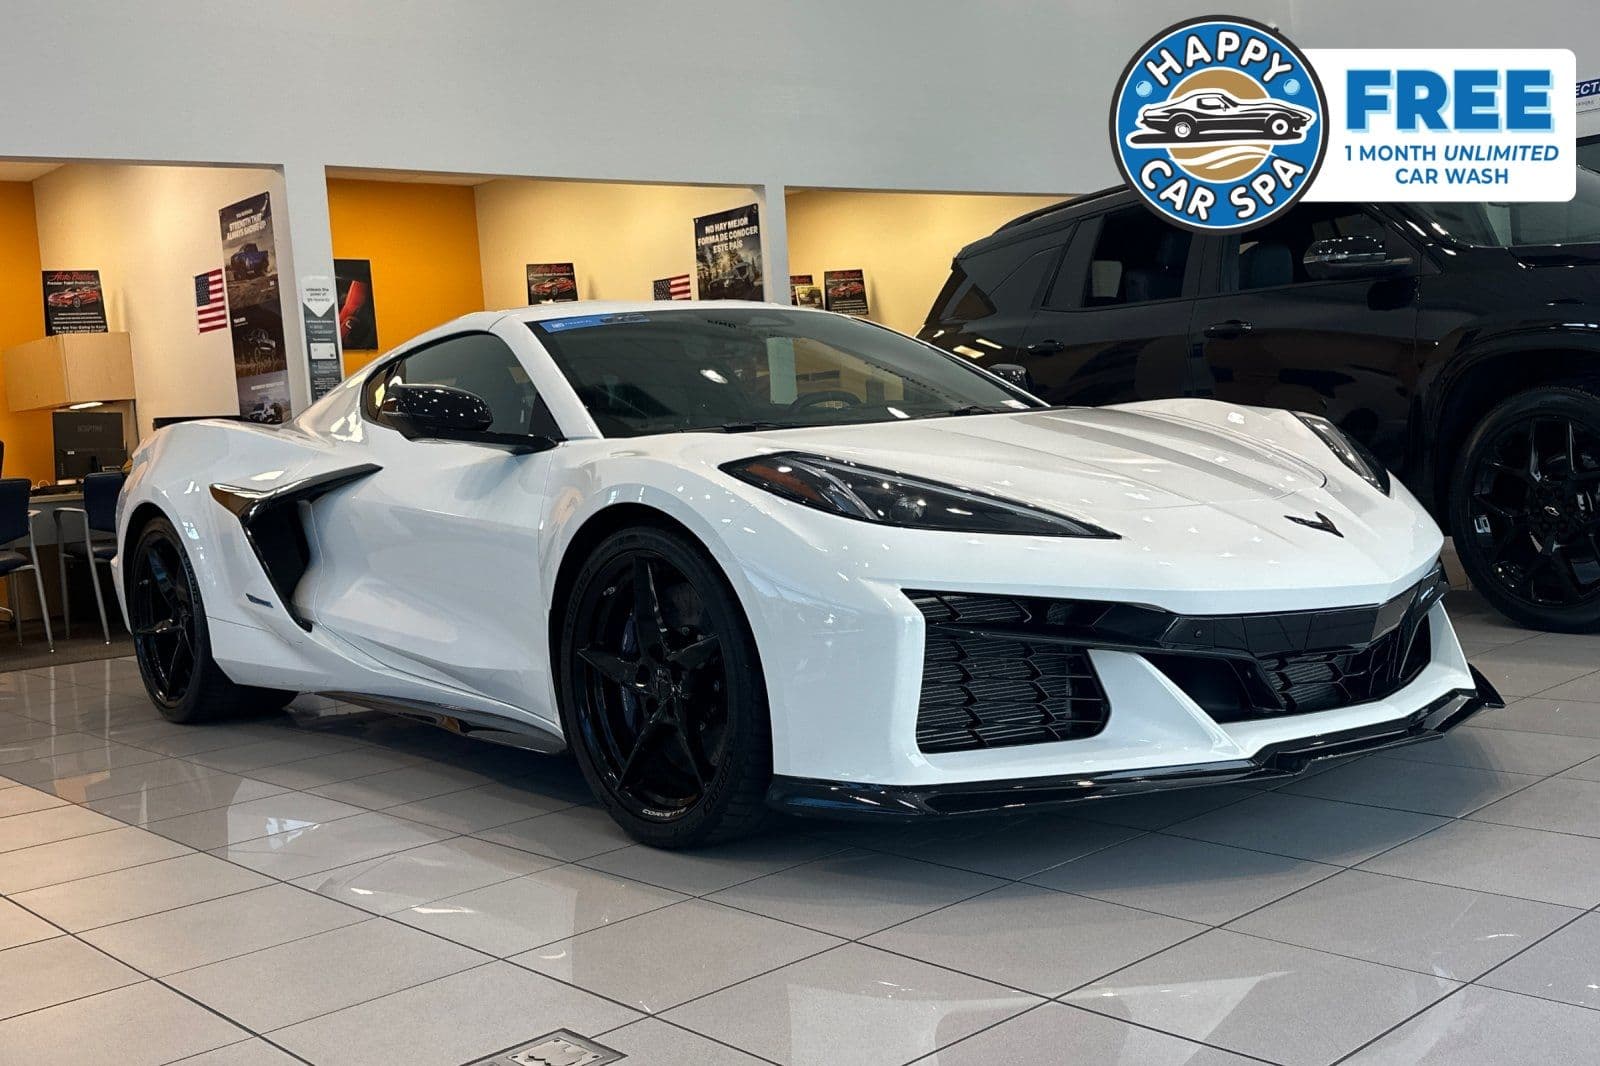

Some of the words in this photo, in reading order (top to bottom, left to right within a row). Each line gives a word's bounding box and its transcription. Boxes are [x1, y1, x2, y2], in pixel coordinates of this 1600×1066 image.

[705, 225, 714, 235] NO
[715, 221, 728, 232] HAY
[727, 217, 748, 229] MEJOR
[697, 235, 720, 247] FORMA
[719, 232, 728, 242] DE
[728, 225, 758, 240] CONOCER
[712, 242, 728, 253] ESTE
[642, 806, 687, 817] CORVETTE
